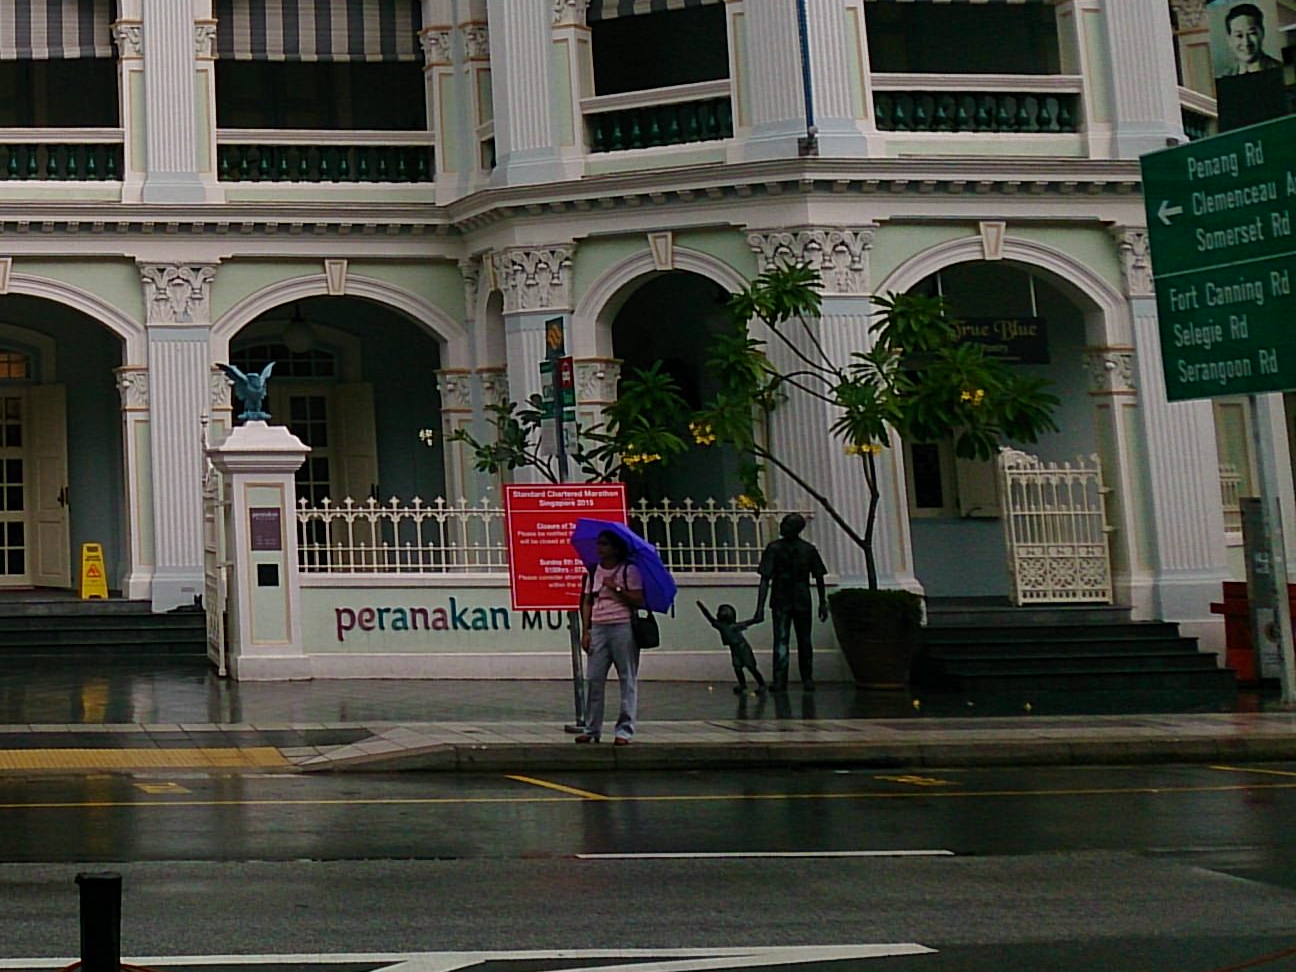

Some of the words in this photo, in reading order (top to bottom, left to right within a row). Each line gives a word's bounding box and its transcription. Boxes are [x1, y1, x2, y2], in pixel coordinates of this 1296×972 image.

[1187, 153, 1239, 181] Penang
[1244, 140, 1265, 167] Rd
[1192, 181, 1278, 216] Clemenceau
[1196, 216, 1265, 252] Somerset
[1270, 210, 1291, 238] Rd
[1169, 285, 1199, 312] Fort
[1205, 277, 1264, 307] Canning
[1270, 269, 1291, 296] Rd
[993, 319, 1039, 341] Blue
[1173, 318, 1223, 350] Selegie
[1229, 314, 1249, 340] Rd
[1177, 358, 1252, 386] Serangoon
[1258, 348, 1279, 375] Rd
[512, 490, 546, 498] Standard
[547, 489, 583, 498] Chartered
[584, 489, 618, 497] Marathon
[539, 499, 576, 508] Singapore
[335, 596, 511, 642] peranakan
